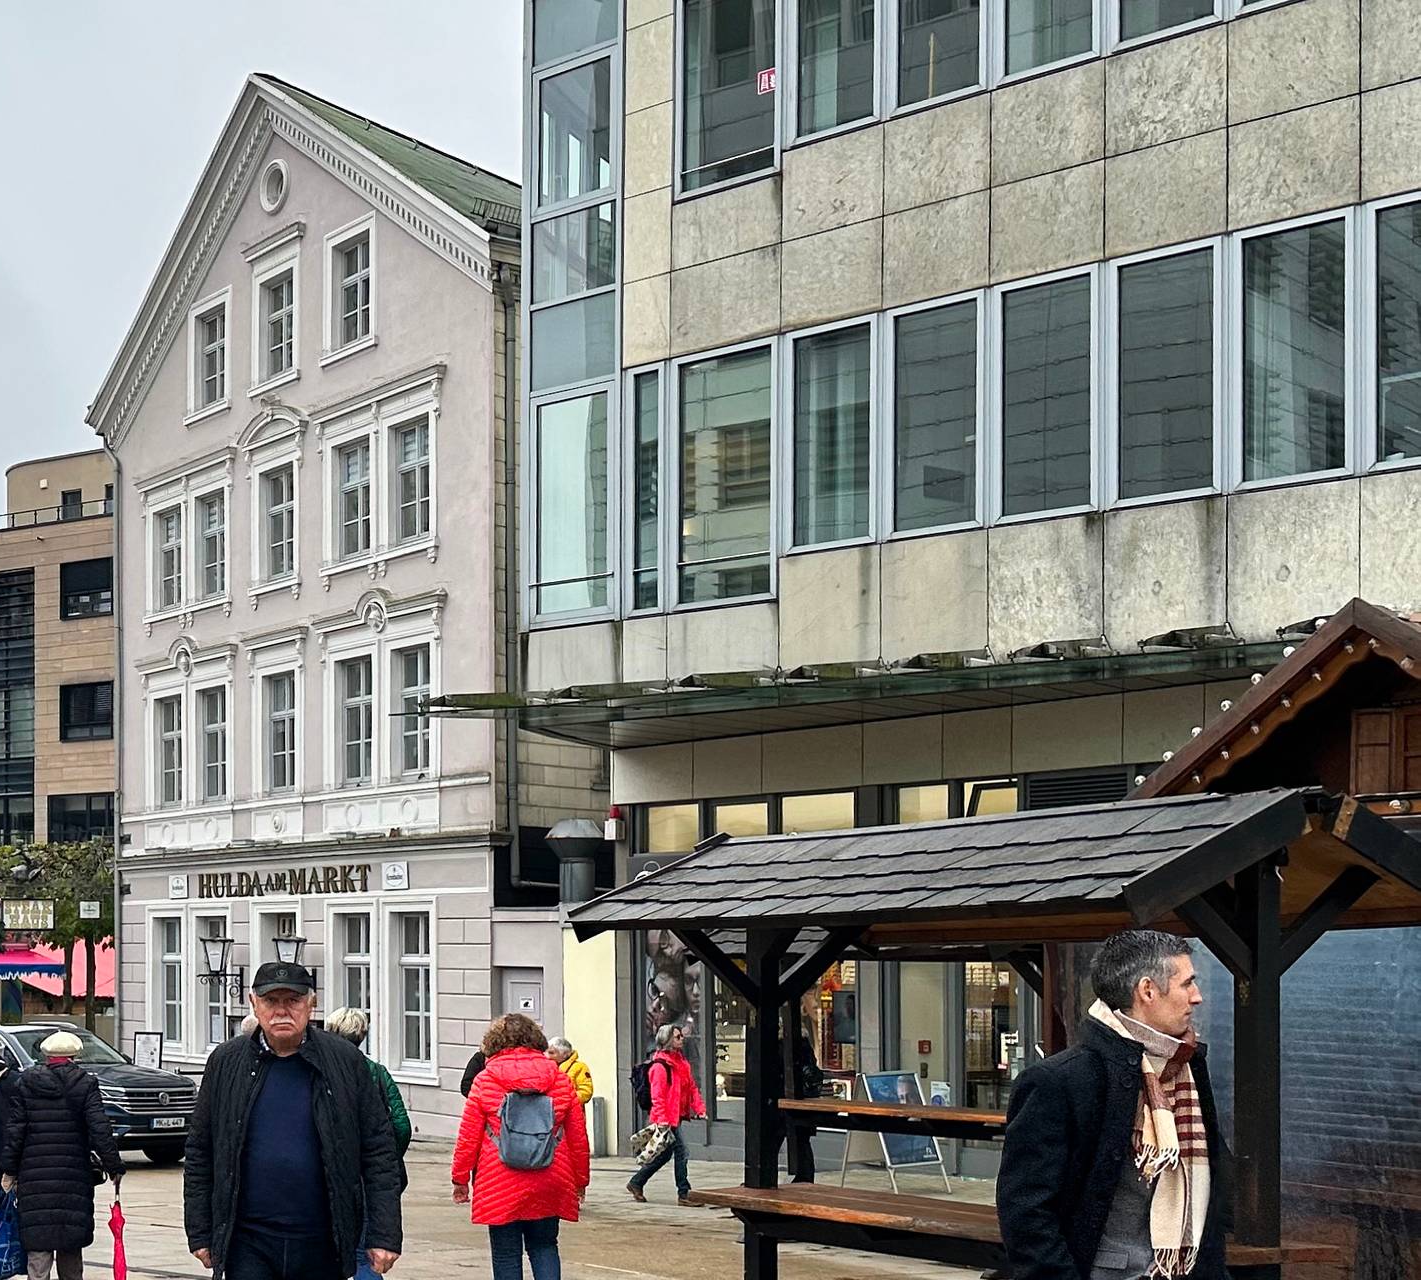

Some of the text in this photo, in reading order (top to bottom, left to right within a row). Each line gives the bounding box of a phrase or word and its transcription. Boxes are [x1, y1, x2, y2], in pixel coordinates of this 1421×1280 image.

[198, 863, 371, 899] HULDA AM MARKT
